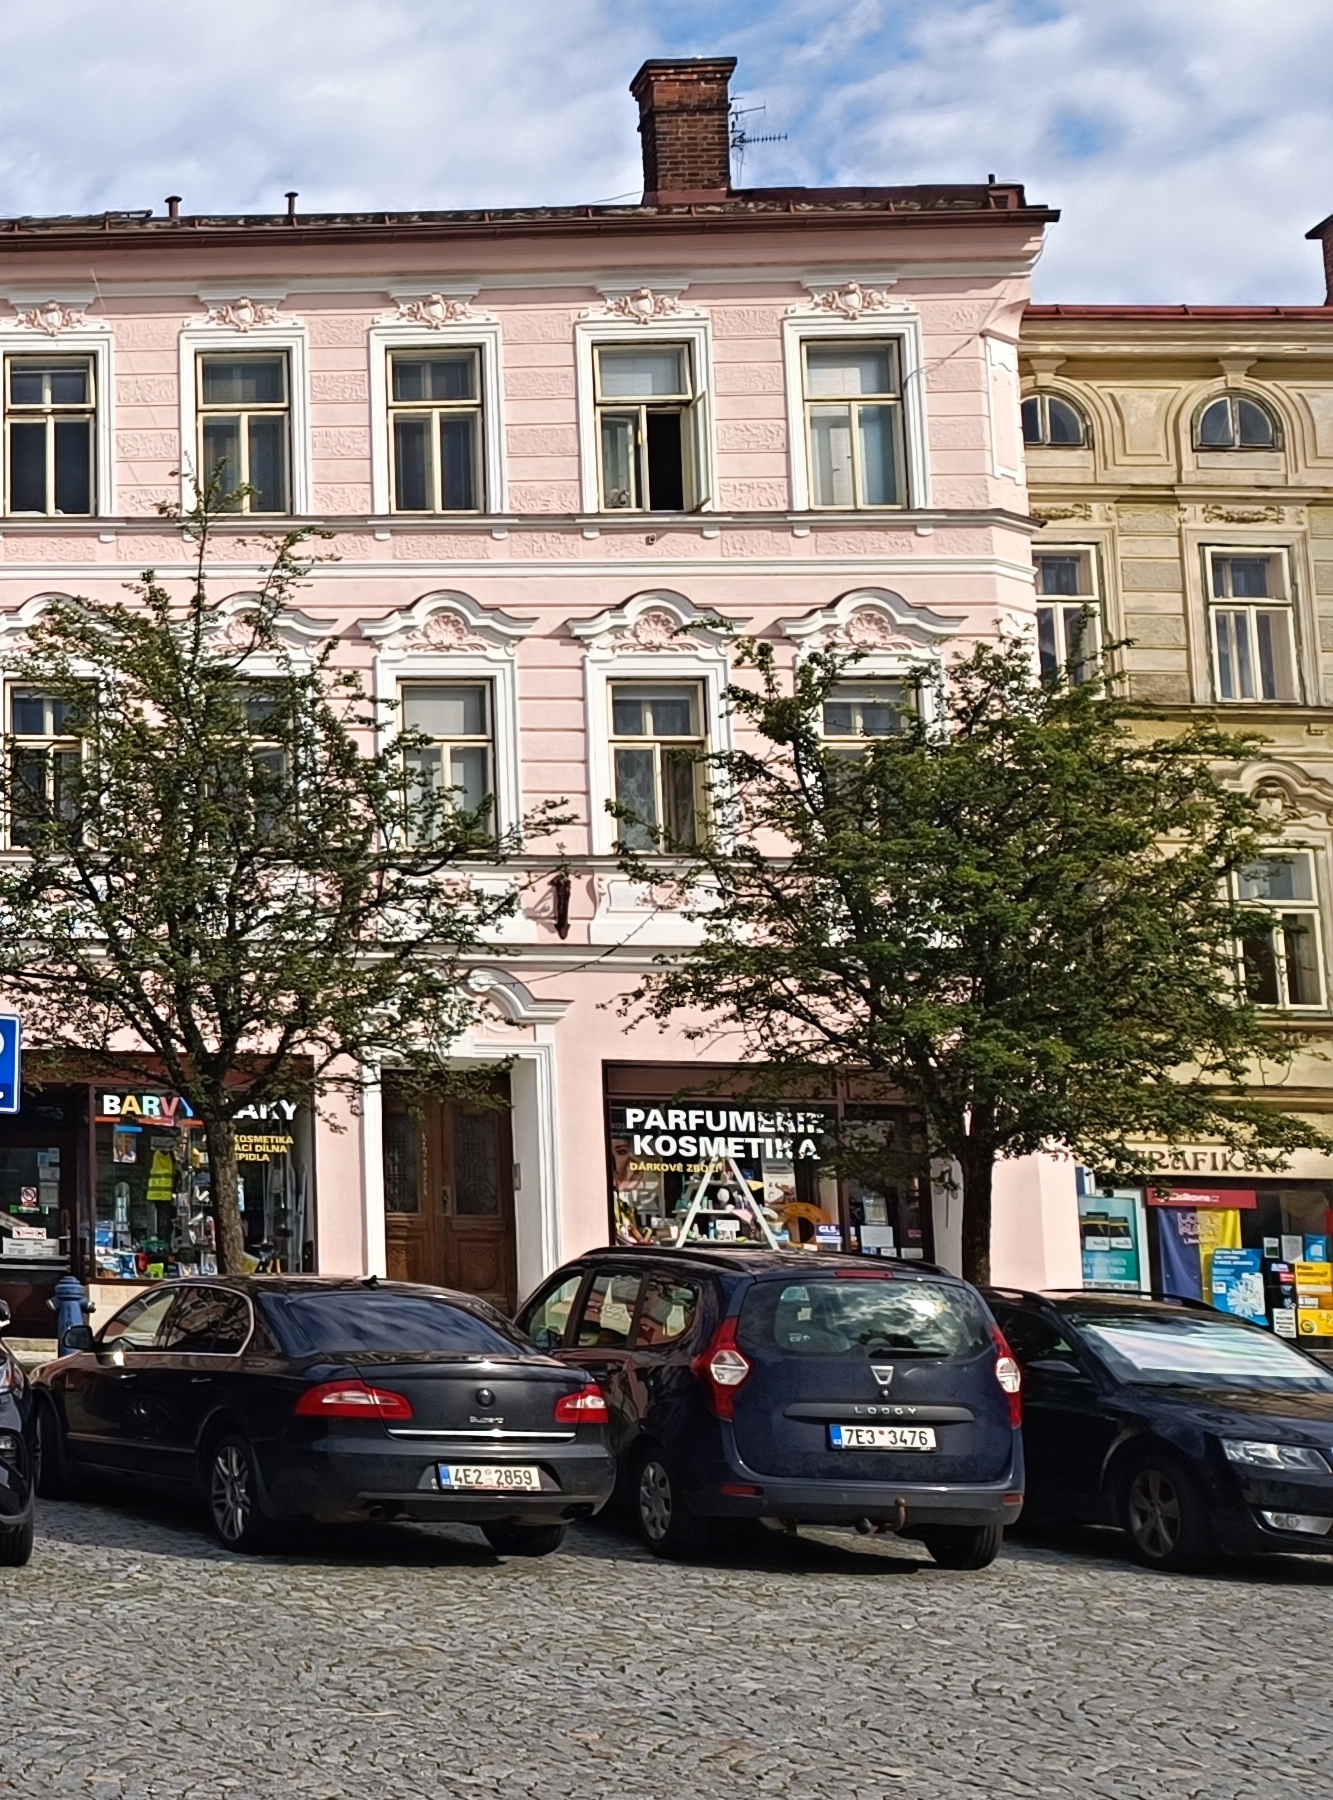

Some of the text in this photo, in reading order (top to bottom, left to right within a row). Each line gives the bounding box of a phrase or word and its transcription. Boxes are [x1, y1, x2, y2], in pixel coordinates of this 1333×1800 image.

[233, 1099, 297, 1120] AKY
[633, 1134, 822, 1160] KOSMETIKA
[235, 1152, 270, 1162] EPIDLA
[1133, 1150, 1265, 1173] RAFIKA
[854, 1406, 917, 1415] LODGY
[844, 1429, 928, 1446] 7E3 3476
[454, 1468, 533, 1486] 4E2 2859
